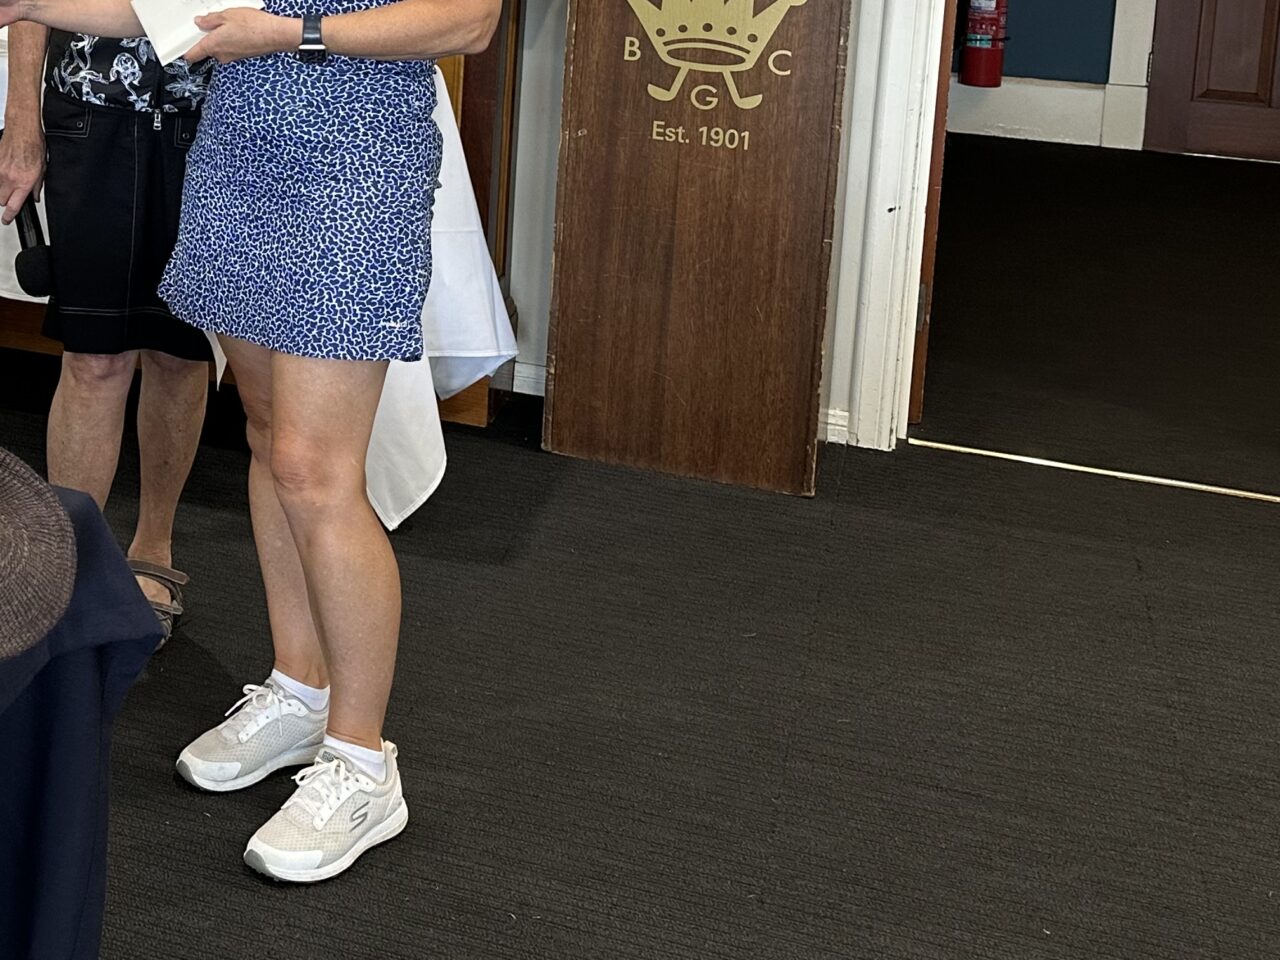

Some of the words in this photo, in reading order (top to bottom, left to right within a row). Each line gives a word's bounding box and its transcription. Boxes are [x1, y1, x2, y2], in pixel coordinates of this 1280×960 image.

[623, 36, 641, 61] B
[767, 50, 792, 76] C
[690, 84, 719, 110] G
[651, 120, 690, 143] Est.
[698, 126, 750, 150] 1901
